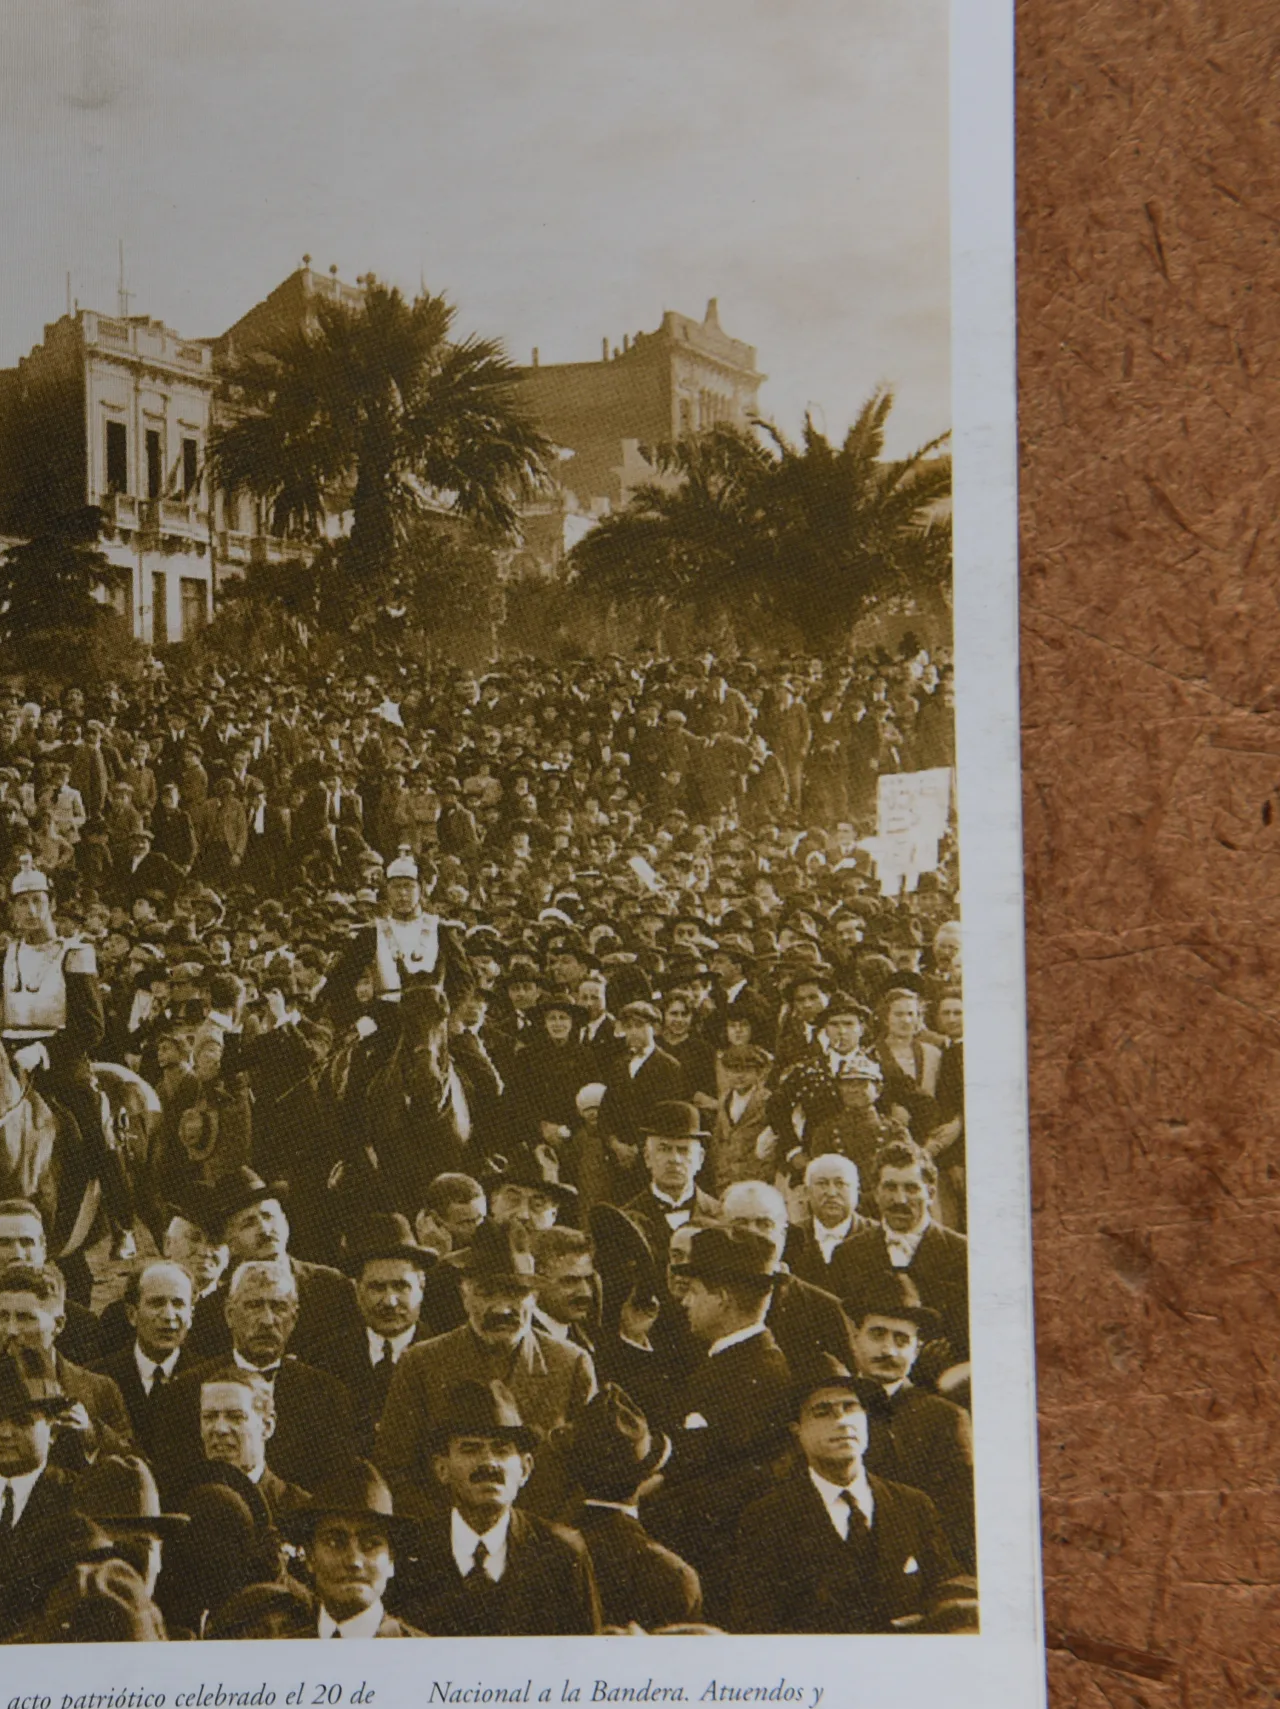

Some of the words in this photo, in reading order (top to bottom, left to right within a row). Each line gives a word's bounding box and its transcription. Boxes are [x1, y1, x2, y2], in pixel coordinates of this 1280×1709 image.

[6, 1692, 52, 1709] acto
[60, 1686, 167, 1709] patriótico
[174, 1681, 277, 1708] celebrado
[285, 1681, 306, 1706] el
[310, 1683, 343, 1706] 20
[349, 1680, 376, 1705] de
[426, 1678, 533, 1704] Nacional
[537, 1687, 552, 1703] a
[560, 1678, 581, 1703] la
[589, 1677, 690, 1703] Bandera.
[698, 1677, 805, 1702] Atuendos
[807, 1687, 825, 1709] y
